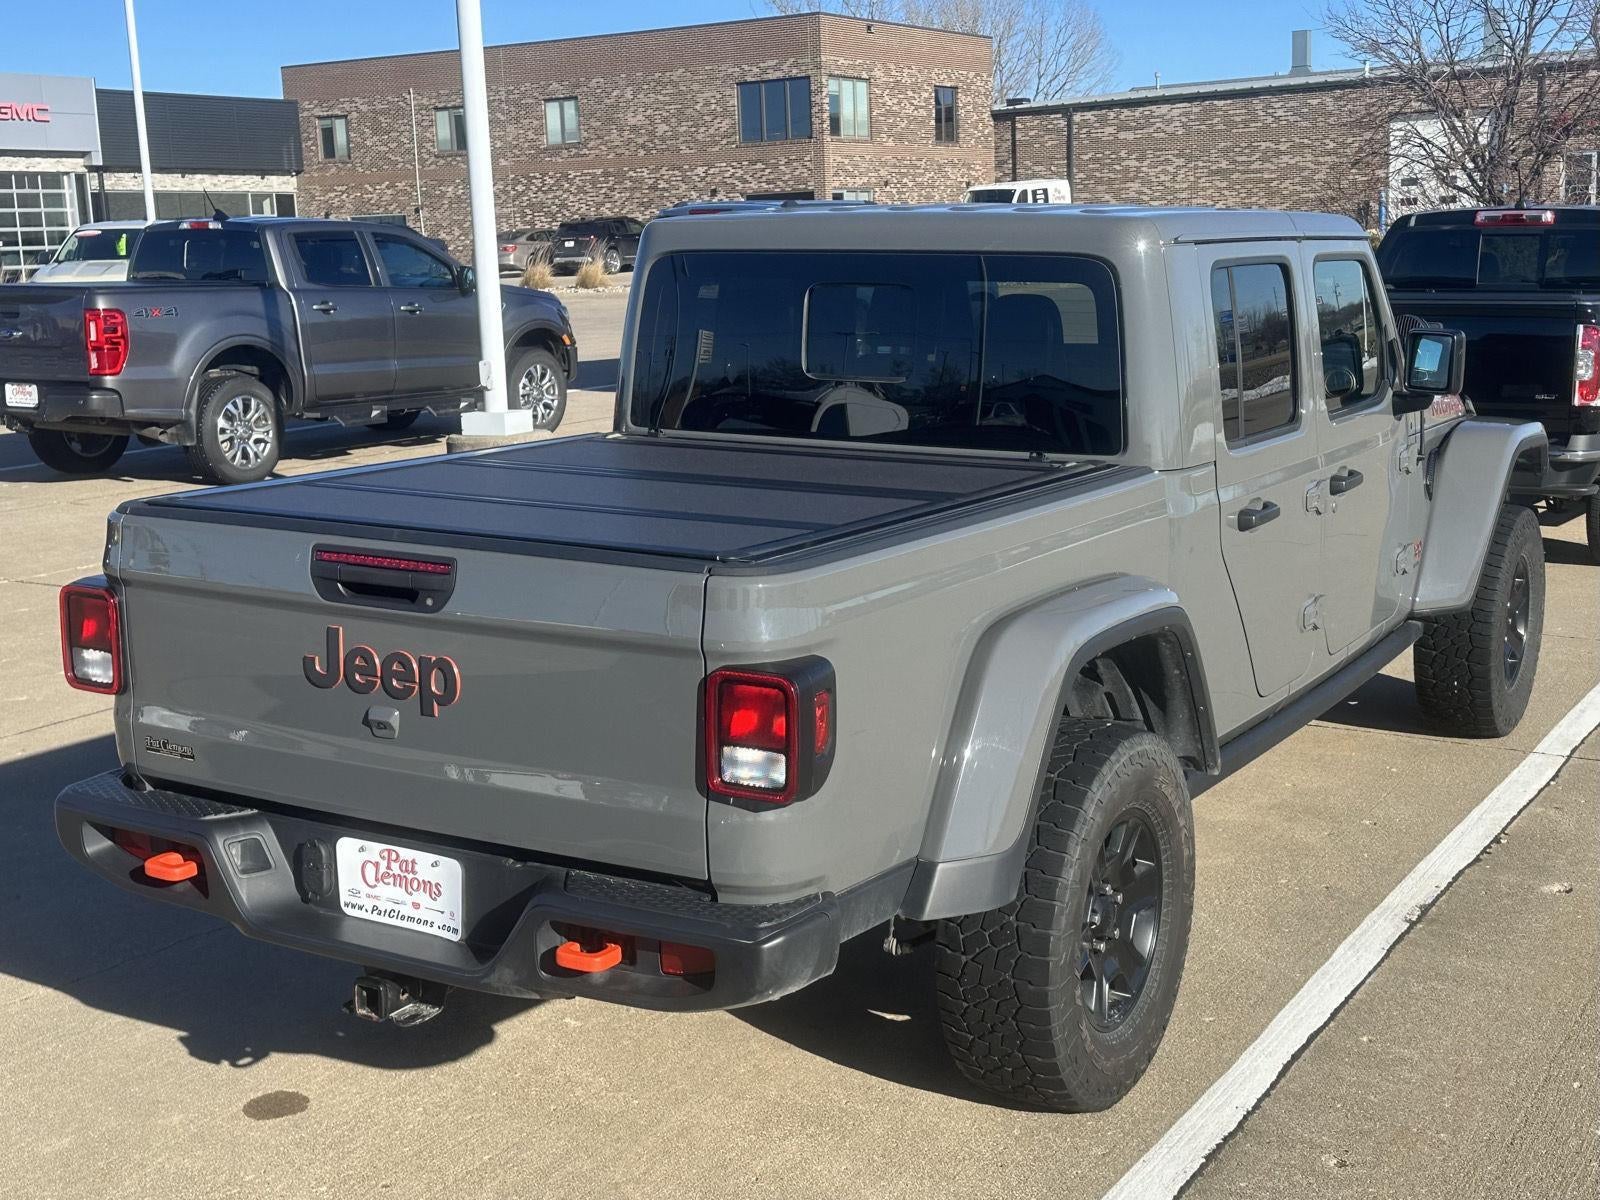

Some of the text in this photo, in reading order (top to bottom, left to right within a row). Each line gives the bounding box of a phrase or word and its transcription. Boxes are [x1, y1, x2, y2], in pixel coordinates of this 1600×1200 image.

[302, 624, 462, 718] Jeep
[360, 860, 443, 902] Clemons
[379, 848, 418, 875] Pat
